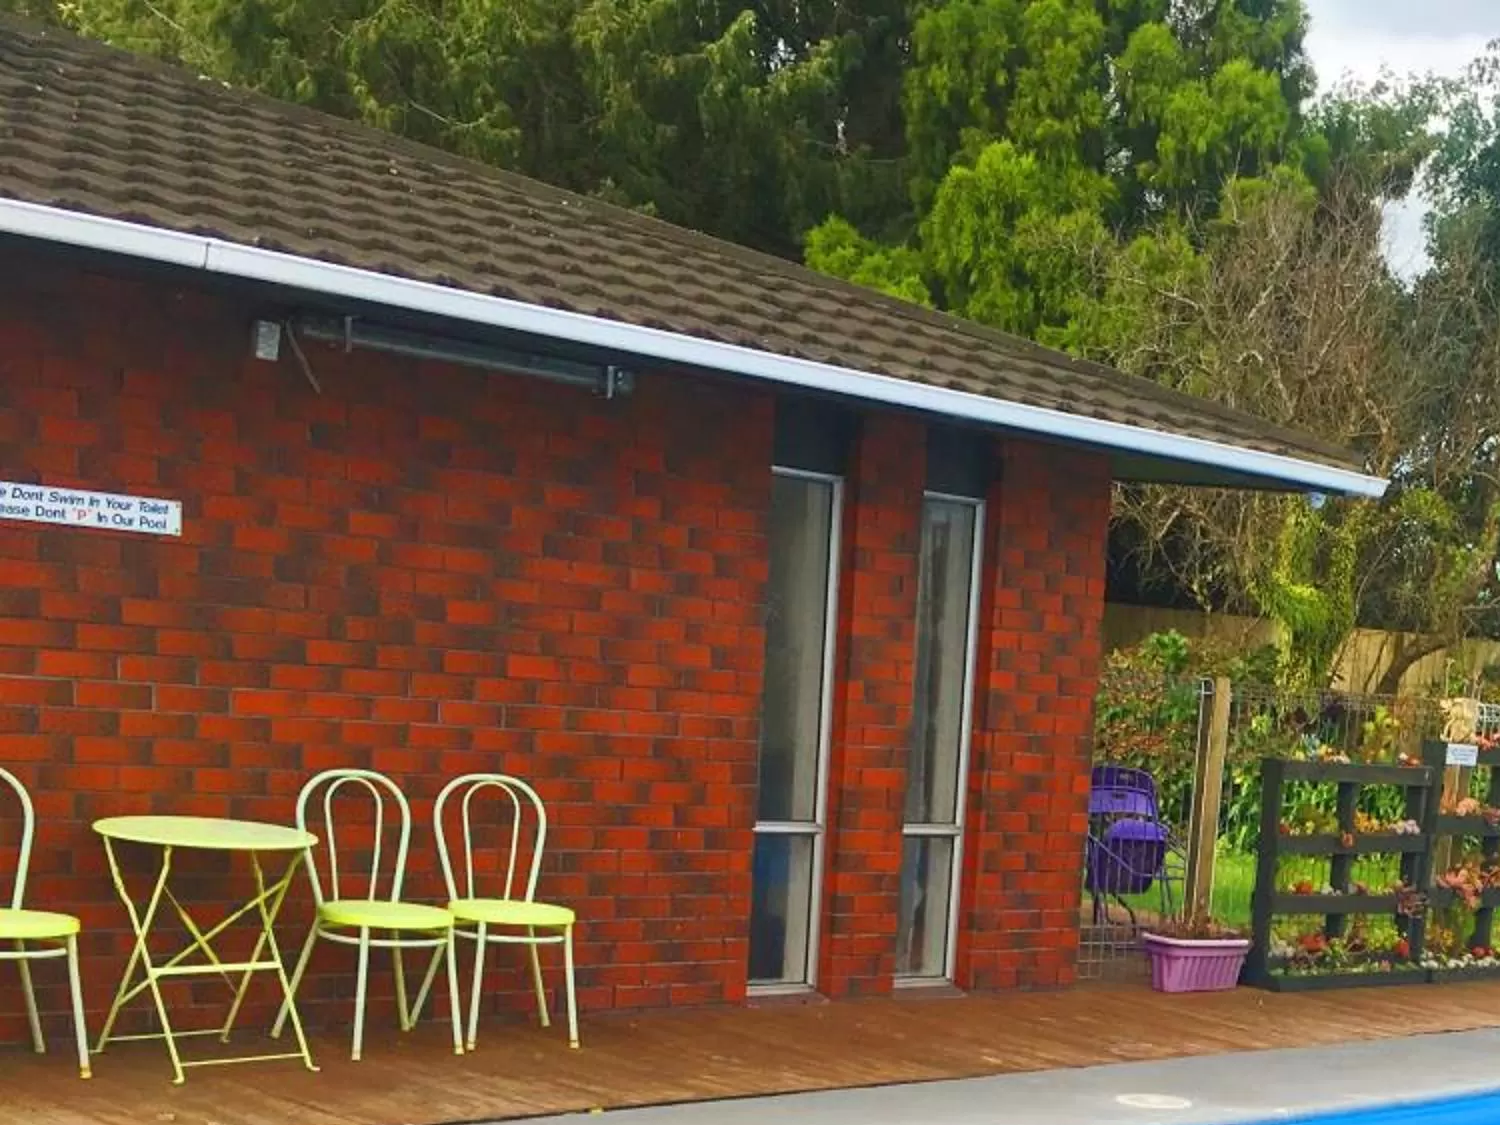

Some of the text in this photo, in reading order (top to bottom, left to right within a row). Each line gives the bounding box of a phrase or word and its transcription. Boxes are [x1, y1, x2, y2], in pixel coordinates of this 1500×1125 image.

[12, 487, 43, 501] Dont
[48, 491, 85, 505] Swim
[106, 497, 133, 510] Your
[35, 505, 66, 519] Dont
[97, 511, 108, 523] In
[111, 513, 134, 526] Our
